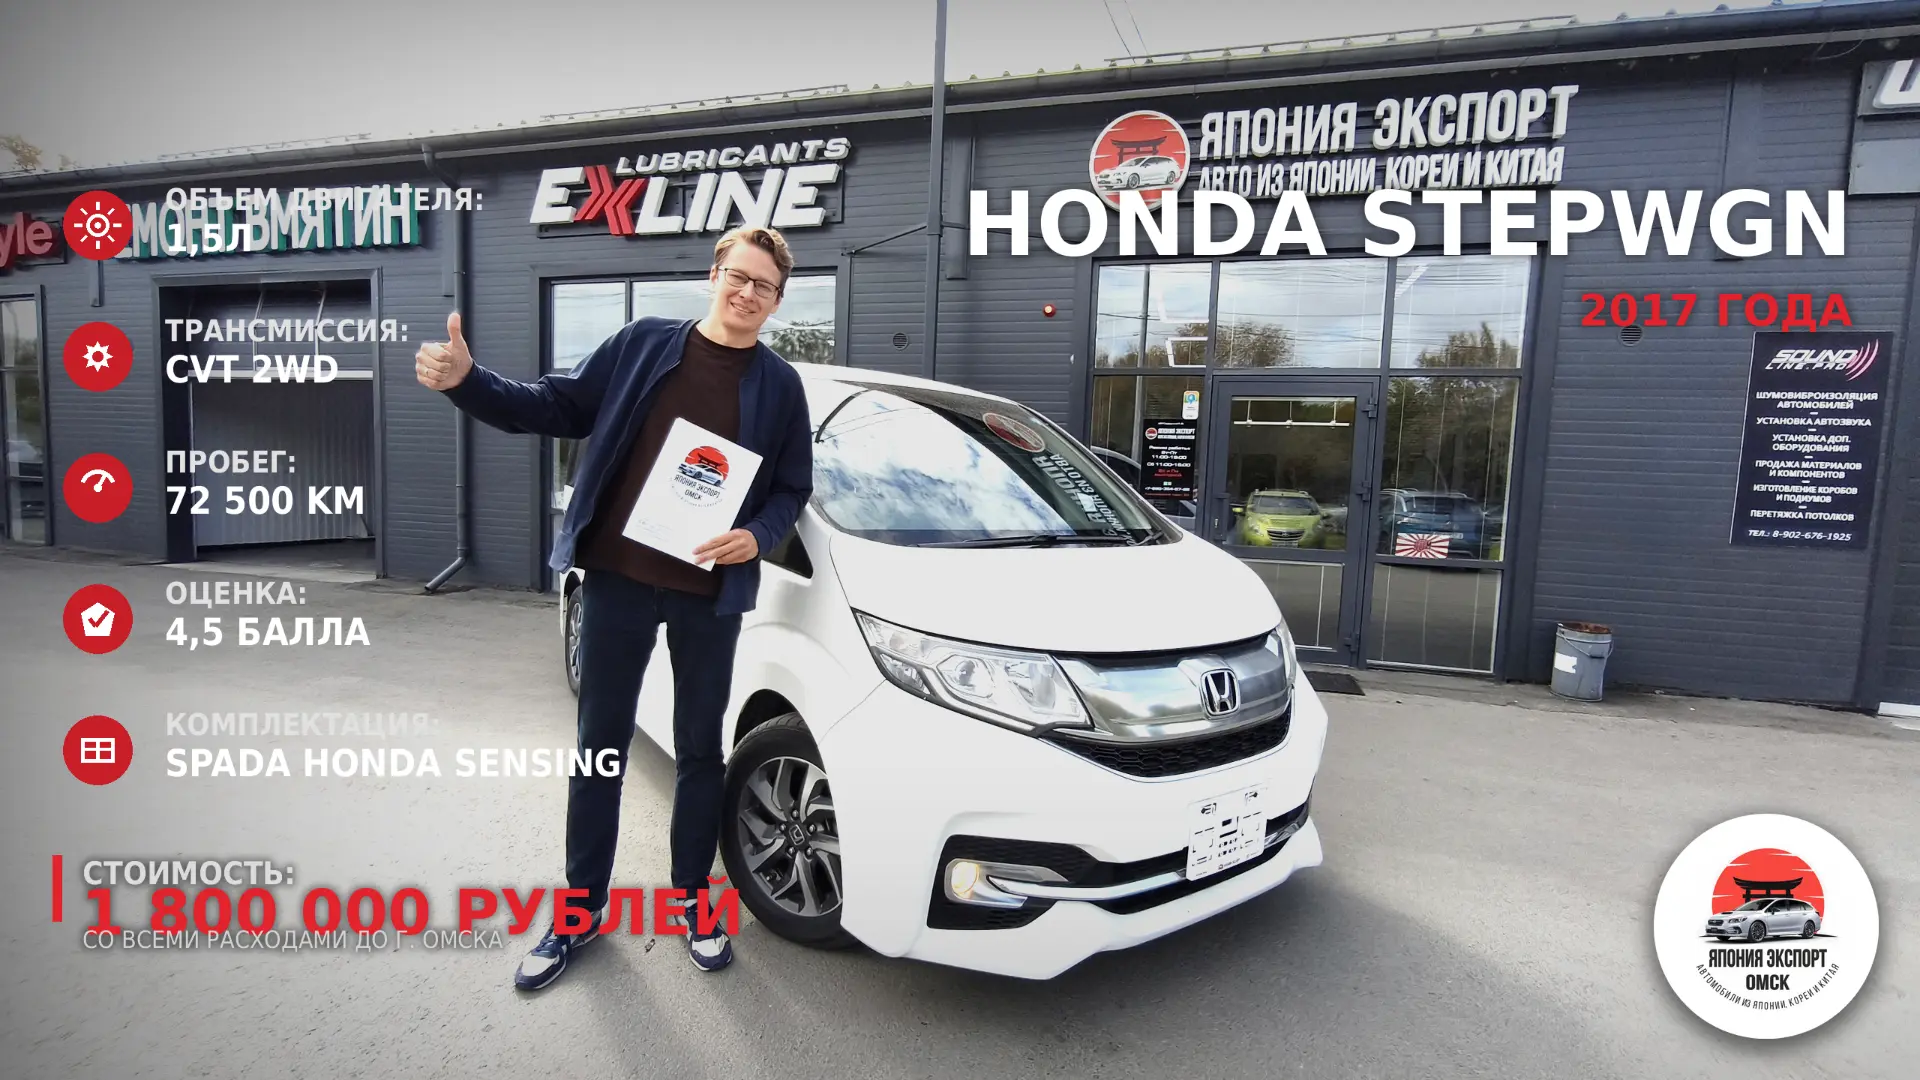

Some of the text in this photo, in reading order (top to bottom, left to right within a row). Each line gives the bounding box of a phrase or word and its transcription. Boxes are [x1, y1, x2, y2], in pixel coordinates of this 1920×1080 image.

[1199, 84, 1579, 160] ЯПОНИЯ ЭКСПОРТ
[615, 137, 850, 176] LUBRICANTS
[1198, 165, 1252, 199] АВТО
[1256, 163, 1284, 198] ИЗ
[1385, 152, 1460, 191] КОРЕИ
[1462, 150, 1481, 189] И
[1483, 146, 1565, 188] КИТАЯ
[530, 163, 841, 236] EXLINE
[1771, 349, 1859, 364] SOUND
[1756, 391, 1878, 401] ШУМОВИБРОИЗОЛЯЦИЯ
[1777, 400, 1854, 409] АВТОМОБИЛЕЙ
[1756, 418, 1871, 426] УСТАНОВКА АВТОЗВУКА
[1772, 434, 1851, 444] УСТАНОВКА ДОП.
[1772, 443, 1850, 453] ОБОРУДОВАНИЯ
[1755, 460, 1862, 470] ПРОДАЖА МАТЕРИАЛОВ
[1777, 470, 1845, 479] КОМПОНЕНТОВ
[674, 474, 721, 499] ЯПОНИЯ ЭКСПОРТ
[1753, 484, 1858, 495] ИЗГОТОВЛЕНИЕ КОРОБОВ
[684, 489, 703, 501] ОМСК
[1784, 495, 1832, 504] ПОДИУМОВ
[1750, 509, 1854, 521] ПЕРЕТЯЖКА ПОТОЛКОВ
[1772, 530, 1852, 541] 8-902-676-1925
